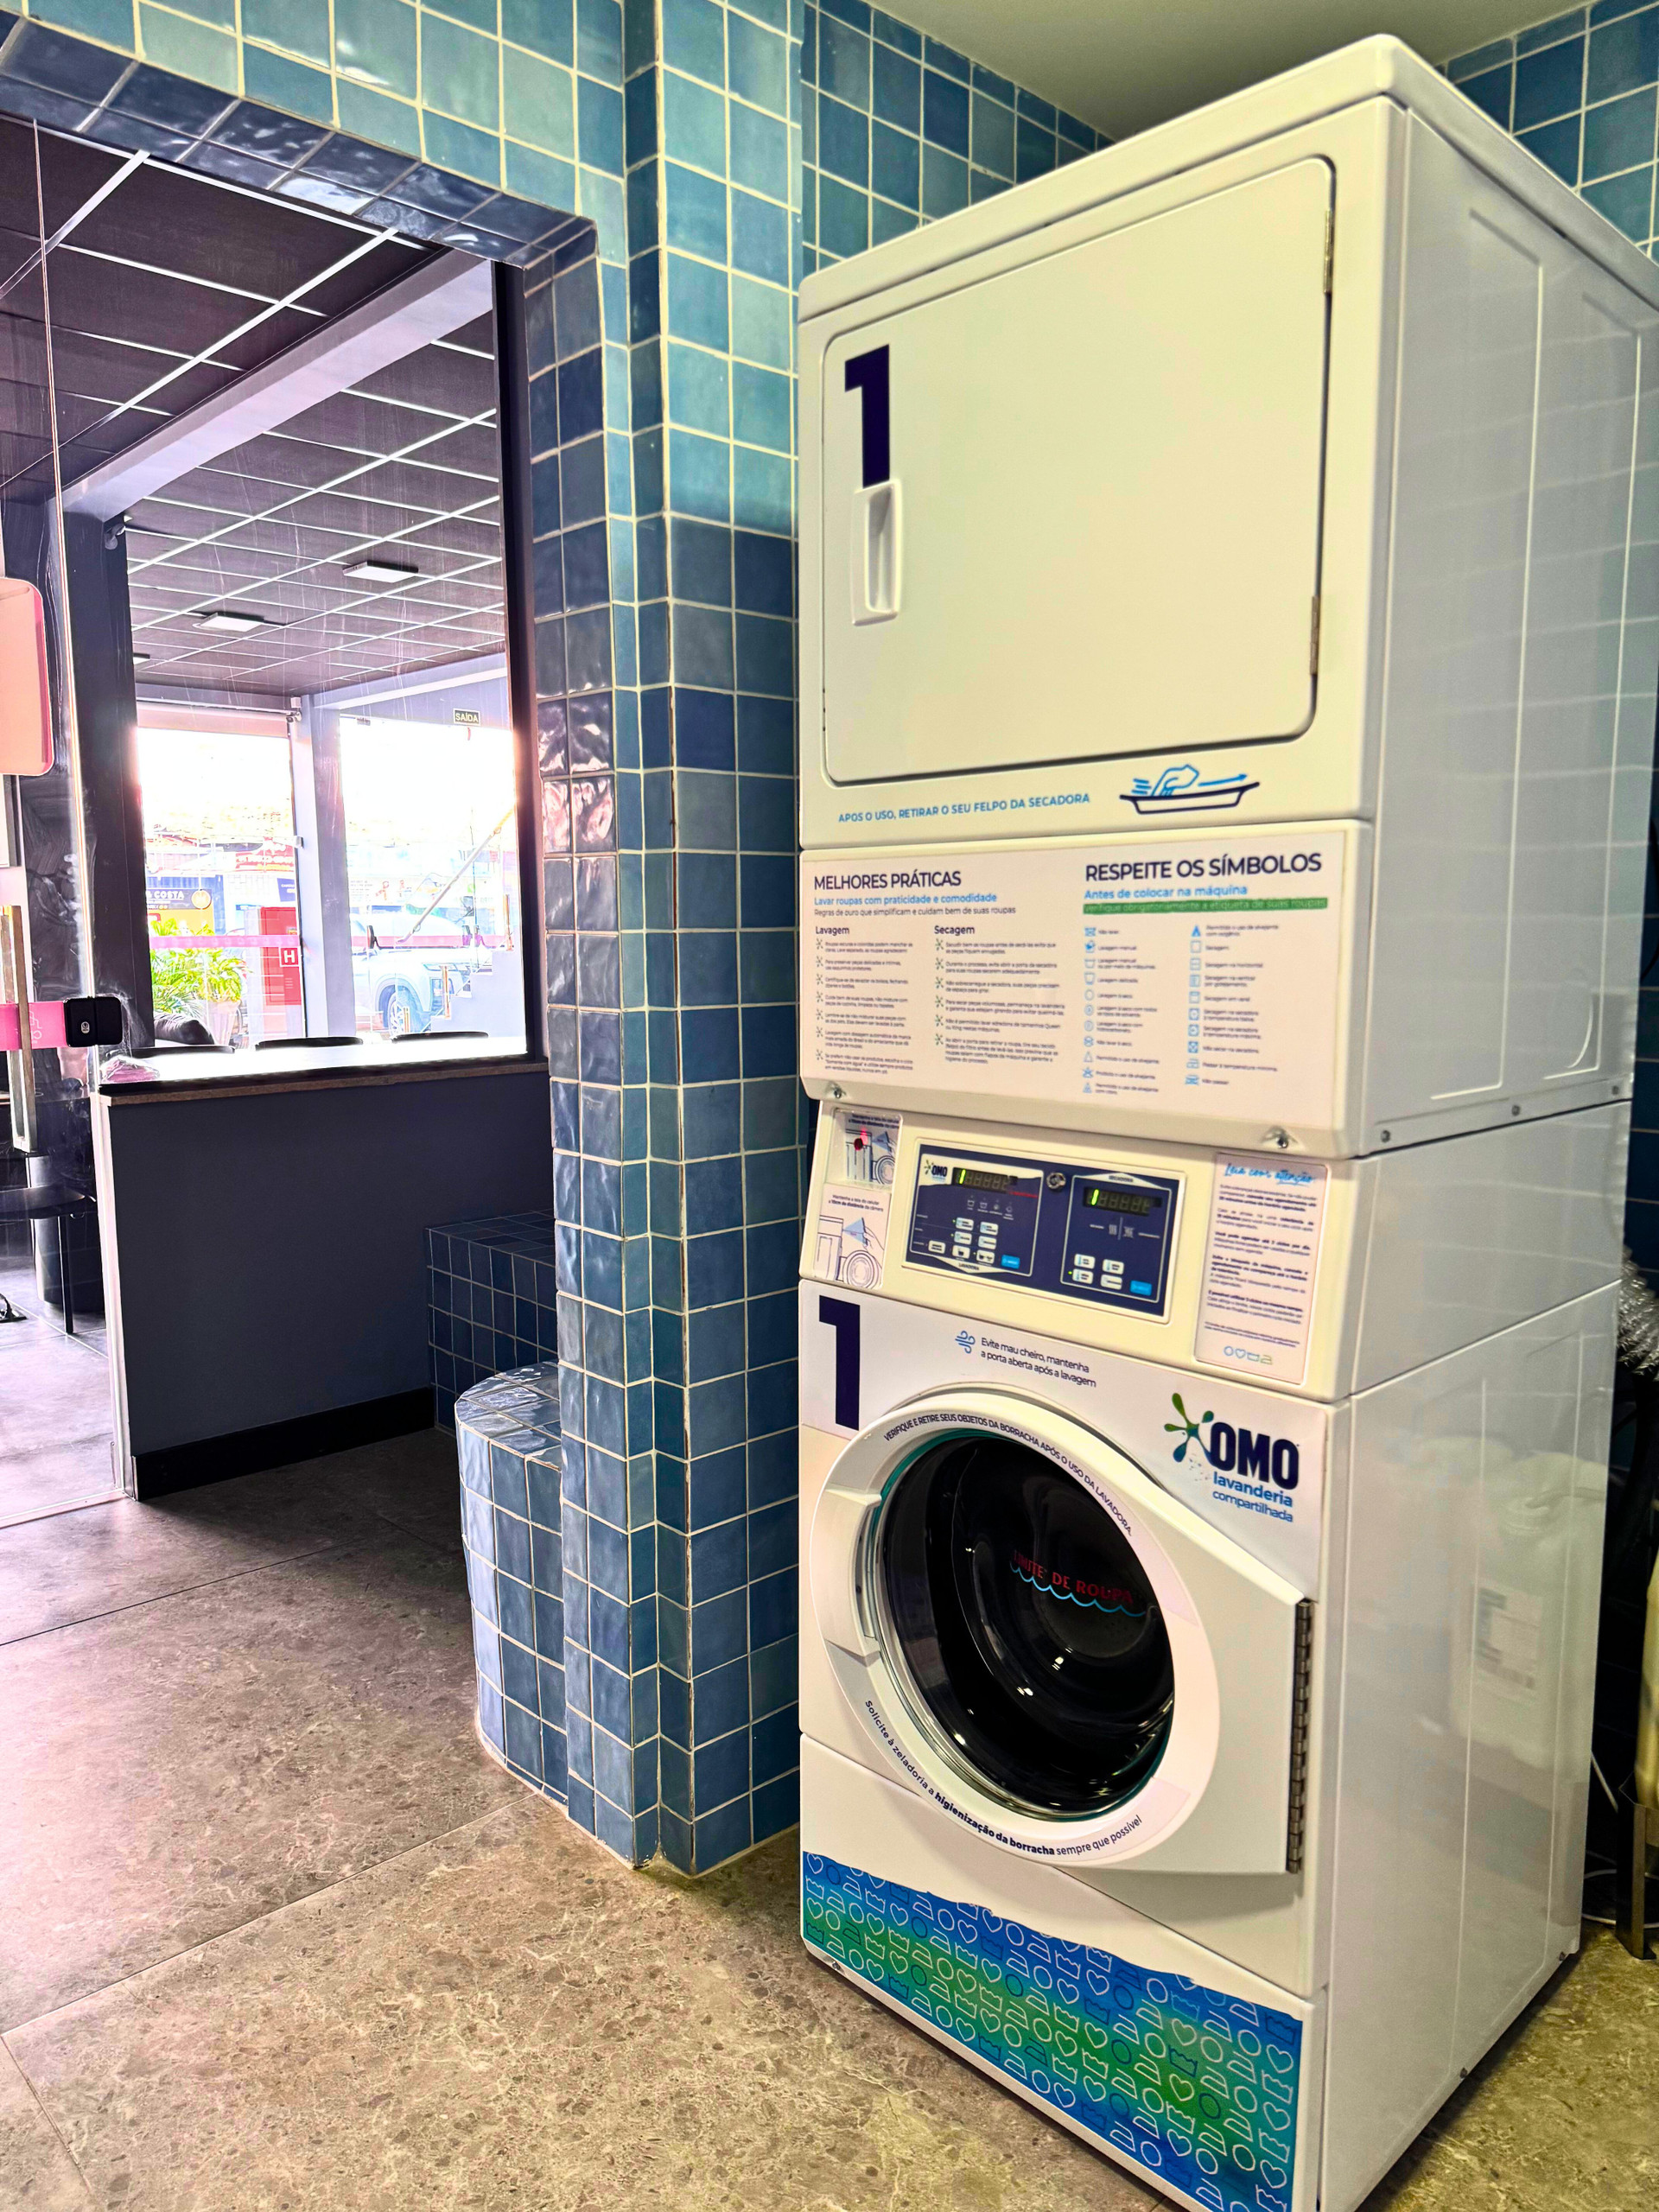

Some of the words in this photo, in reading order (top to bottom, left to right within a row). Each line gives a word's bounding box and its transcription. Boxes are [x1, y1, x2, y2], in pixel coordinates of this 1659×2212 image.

[844, 344, 890, 489] 1
[454, 709, 478, 723] SAÍDA
[838, 813, 863, 823] APOS
[865, 812, 873, 821] O
[874, 810, 896, 820] USO,
[899, 807, 938, 818] RETIRAR
[941, 805, 950, 815] O
[951, 804, 970, 814] SEU
[974, 800, 1007, 812] FELPO
[1010, 798, 1026, 809] DA
[1028, 793, 1090, 808] SECADORA
[814, 874, 887, 890] MELHORES
[891, 869, 962, 888] PRÁTICAS
[1085, 861, 1172, 881] RESPEITE
[1176, 860, 1205, 878] OS
[1209, 853, 1321, 876] SÍMBOLOS
[154, 890, 184, 899] COSTA
[814, 897, 834, 906] Lavar
[836, 897, 862, 906] roupas
[864, 896, 880, 905] com
[883, 894, 931, 906] praticidade
[941, 893, 997, 903] comodidade
[1084, 890, 1114, 899] Antes
[1117, 889, 1131, 899] de
[1134, 888, 1173, 898] colocar
[1177, 888, 1191, 897] na
[1195, 885, 1248, 898] máquina
[874, 907, 911, 917] simplificam
[816, 926, 849, 936] Lavagem
[934, 925, 975, 936] Secagem
[284, 950, 296, 963] H
[931, 1165, 948, 1177] OMO
[819, 1296, 860, 1431] 1
[982, 1337, 1000, 1350] Evite
[1001, 1344, 1019, 1354] mau
[1020, 1348, 1046, 1363] cheiro,
[1046, 1355, 1090, 1373] mantenha
[987, 1352, 1007, 1363] porta
[1008, 1357, 1033, 1370] aberta
[1034, 1365, 1053, 1376] após
[1061, 1370, 1096, 1388] lavagem
[883, 1421, 913, 1441] VERIFIQUE
[918, 1414, 940, 1425] RETIRE
[957, 1414, 988, 1427] OBJETOS
[988, 1419, 999, 1429] DA
[1000, 1422, 1040, 1446] BORRACHA
[1040, 1442, 1060, 1460] APÓS
[1061, 1455, 1068, 1465] O
[1068, 1460, 1084, 1478] USO
[1084, 1473, 1096, 1490] DA
[1211, 1422, 1299, 1490] OMO
[1213, 1471, 1293, 1507] lavanderia
[1212, 1491, 1294, 1522] compartilhada
[1052, 1572, 1071, 1590] DE
[1076, 1580, 1133, 1604] ROUPA
[865, 1700, 890, 1738] Solicite
[888, 1738, 894, 1746] à
[893, 1745, 928, 1789] zeladoria
[928, 1787, 934, 1796] a
[935, 1792, 995, 1838] higienização
[995, 1832, 1008, 1845] da
[1009, 1837, 1055, 1856] borracha
[1056, 1844, 1091, 1856] sempre
[1092, 1837, 1109, 1851] que
[1110, 1815, 1142, 1845] possível
